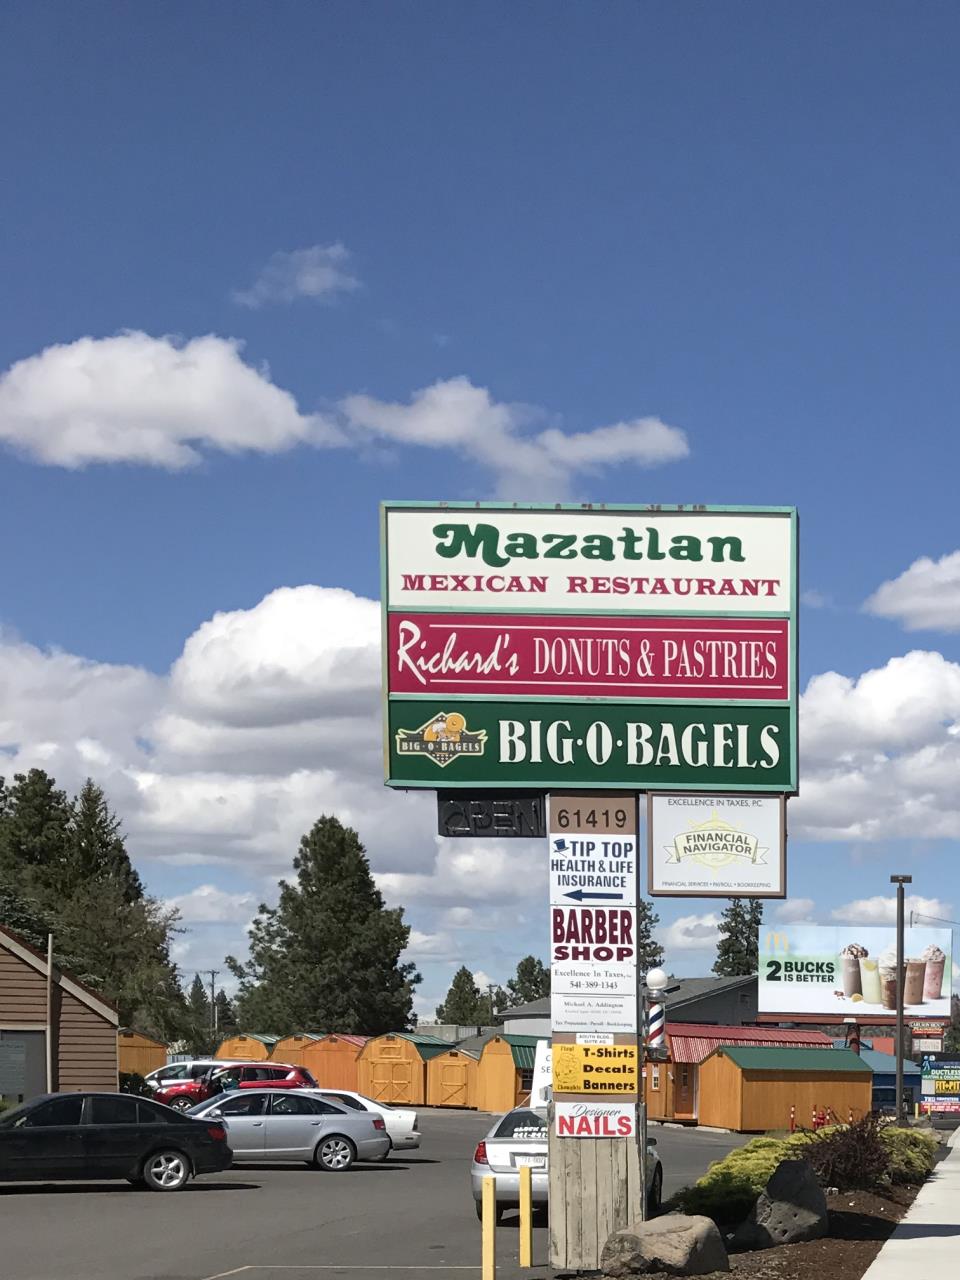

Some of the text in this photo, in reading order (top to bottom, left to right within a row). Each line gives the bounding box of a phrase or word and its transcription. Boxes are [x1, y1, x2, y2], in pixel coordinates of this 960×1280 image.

[432, 523, 746, 568] Mazatlan
[402, 574, 781, 597] MEXICAN RESTAURANT
[397, 620, 777, 685] Richard's DONUTS & PASTRIES
[667, 798, 715, 807] EXCELLENCE
[716, 799, 725, 807] IN
[726, 799, 751, 808] TAXES,
[557, 808, 627, 828] 61419
[685, 832, 750, 846] FINANCIAL
[569, 841, 633, 858] TIP TOP
[683, 842, 752, 855] NAVIGATOR
[551, 859, 633, 874] HEALTH & LIFE
[557, 874, 627, 888] INSURANCE
[552, 908, 633, 945] BARBER
[554, 946, 634, 962] SHOP
[766, 960, 835, 982] 2 BUCKS
[570, 980, 618, 989] 541-389-1343
[784, 974, 835, 983] IS BETTER
[583, 1048, 635, 1059] T-Shirts
[583, 1064, 635, 1074] Decals
[583, 1079, 635, 1091] Banners
[572, 1103, 621, 1117] Designer
[558, 1115, 632, 1136] NAILS
